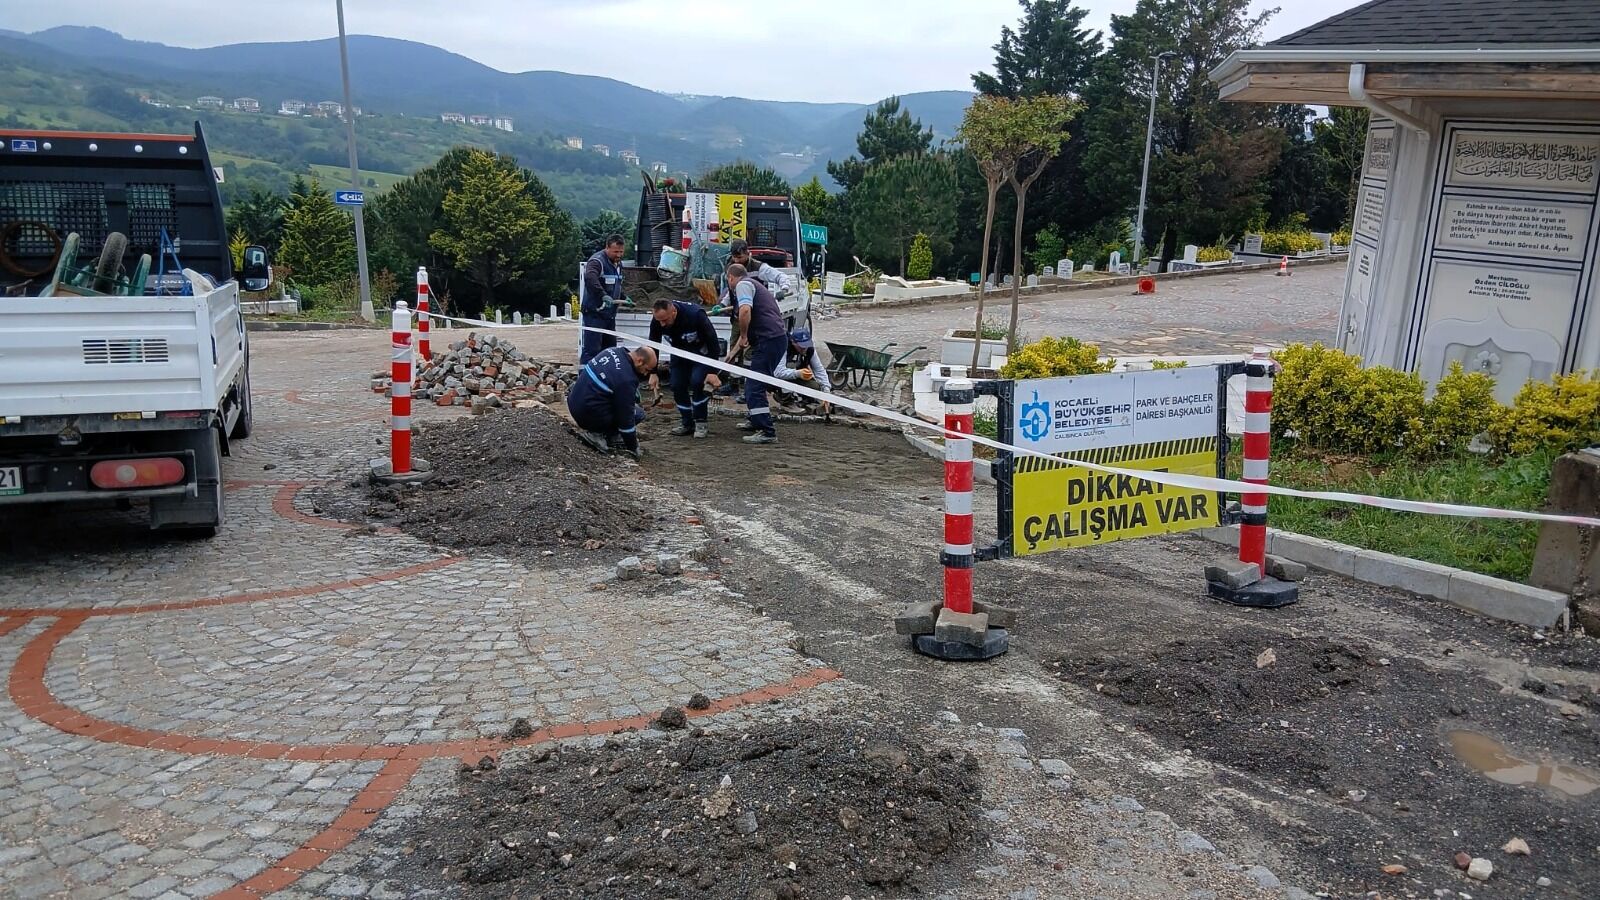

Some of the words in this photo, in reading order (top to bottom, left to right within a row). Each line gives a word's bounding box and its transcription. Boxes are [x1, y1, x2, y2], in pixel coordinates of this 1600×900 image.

[733, 200, 743, 226] VAR
[807, 229, 826, 241] ADA
[1055, 397, 1099, 408] KOCAELİ
[1136, 399, 1157, 408] PARK
[1160, 397, 1170, 405] VE
[1172, 393, 1213, 405] BAHÇELER
[1055, 404, 1131, 419] BÜYÜKŞEHİR
[1136, 408, 1166, 420] DAİRESİ
[1169, 405, 1213, 418] BAŞKANLIĞI
[1055, 416, 1113, 429] BELEDİYESİ
[1068, 467, 1169, 505] DİKKAT
[1023, 502, 1147, 550] ÇALIŞMA
[1156, 494, 1209, 524] VAR
